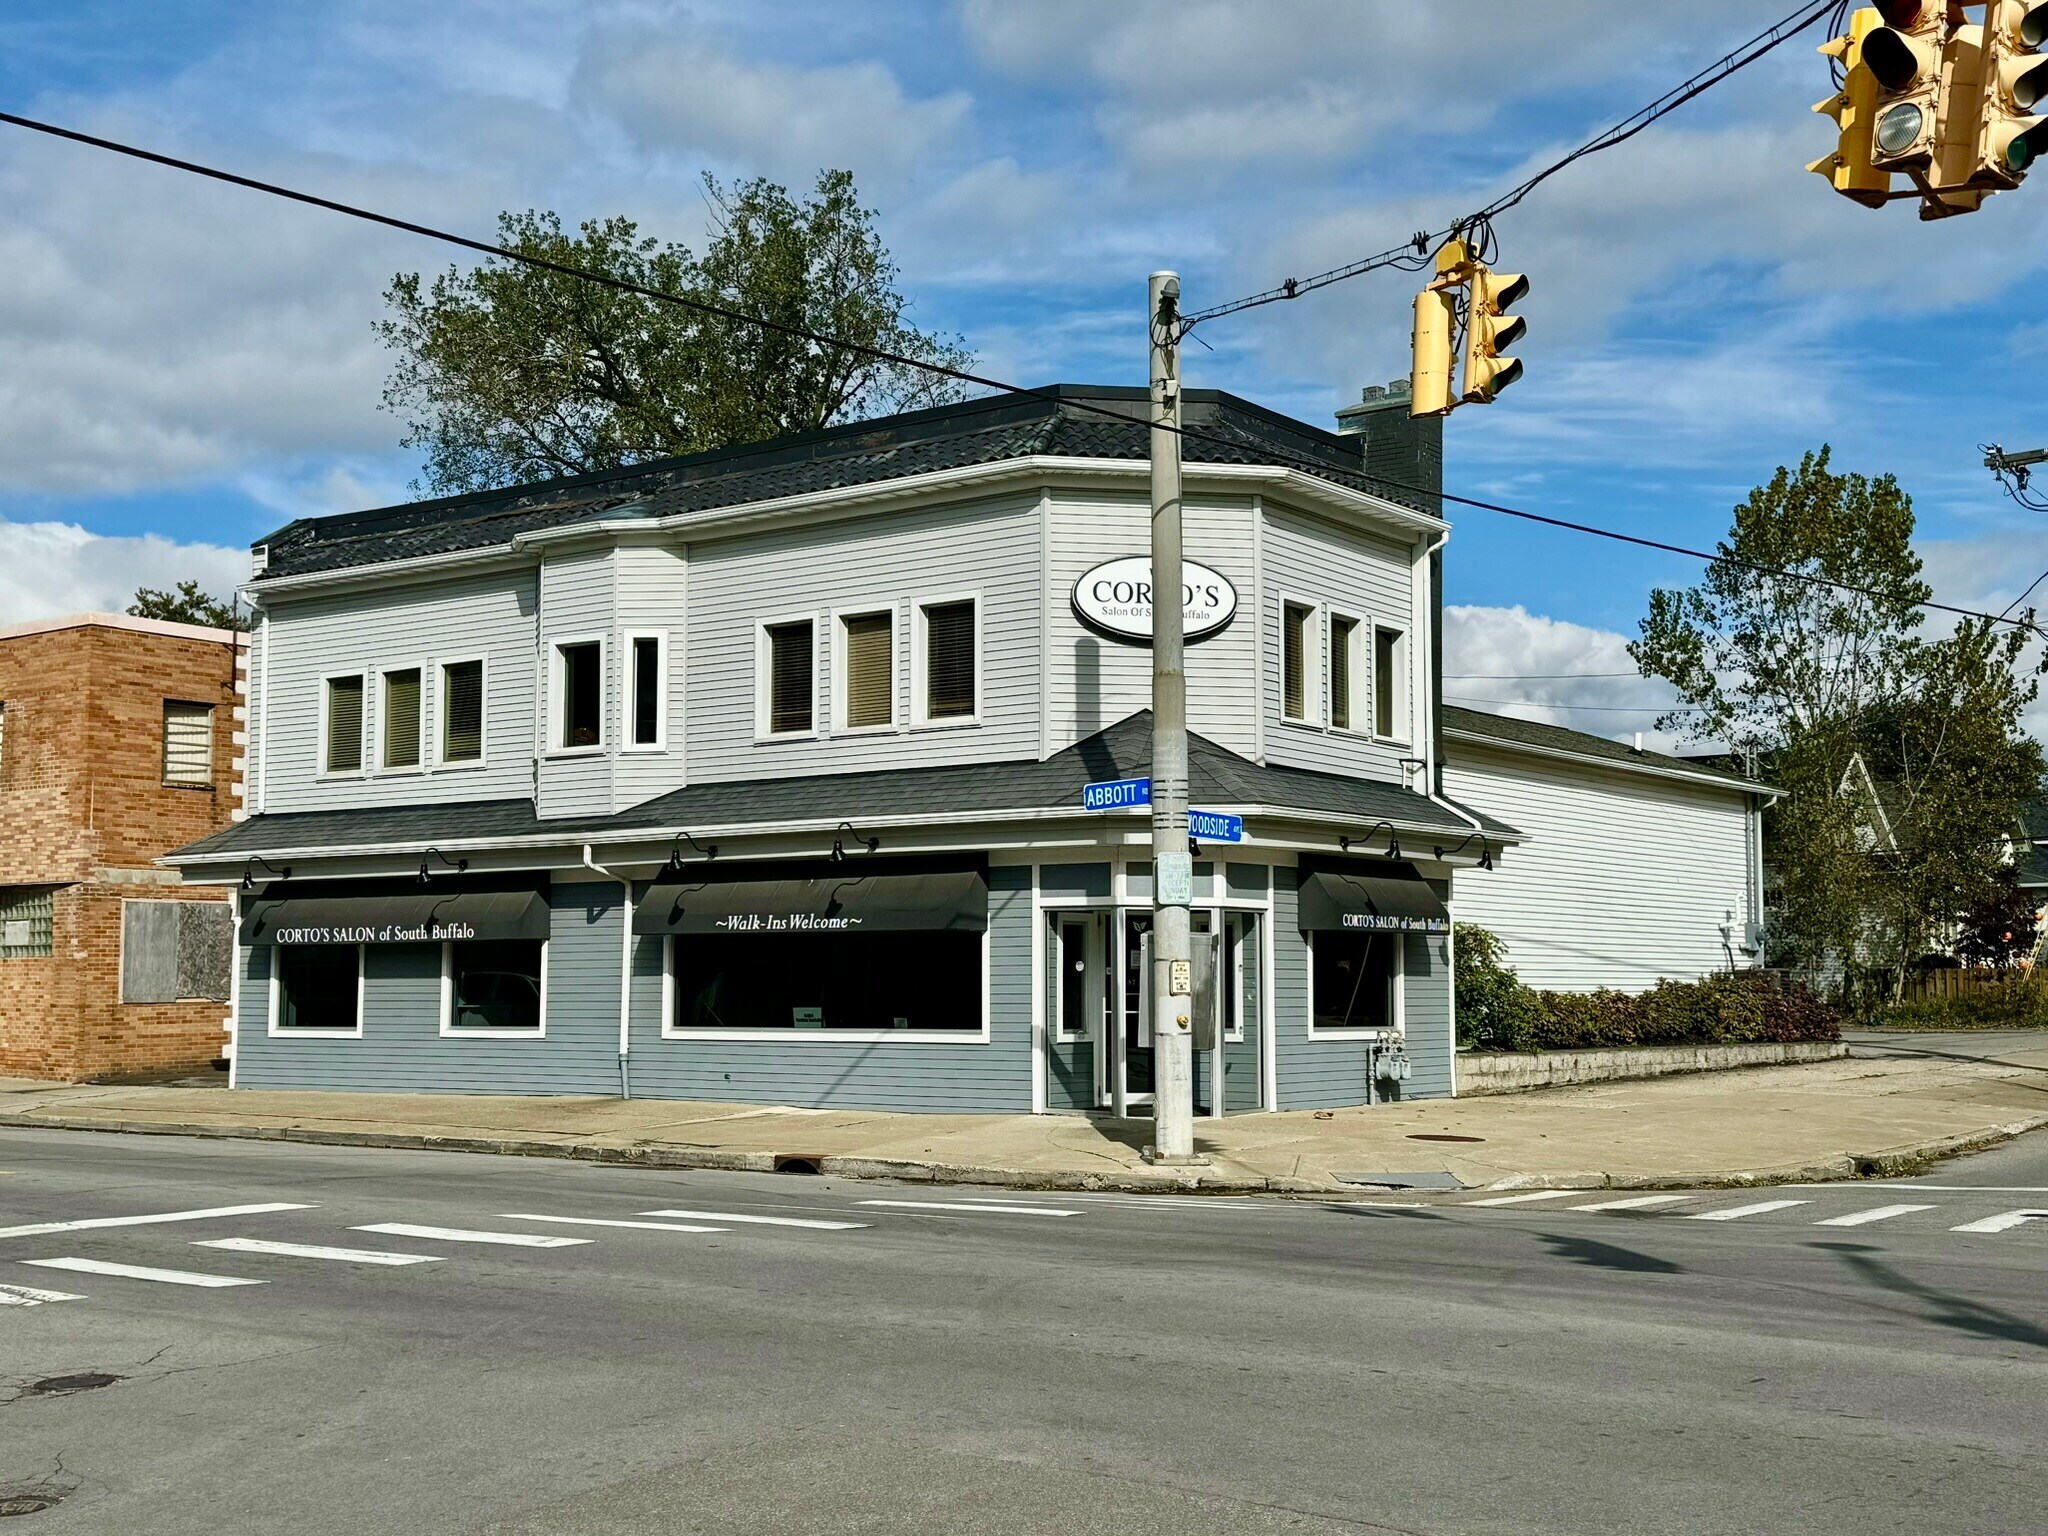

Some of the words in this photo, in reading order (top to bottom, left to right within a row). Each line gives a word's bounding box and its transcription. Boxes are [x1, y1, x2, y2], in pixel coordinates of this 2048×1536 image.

[1093, 581, 1219, 607] CORO'S
[1102, 606, 1128, 616] Salon
[1131, 607, 1144, 617] Of
[1182, 610, 1210, 619] uffalo
[1087, 784, 1136, 806] ABBOTT
[276, 927, 330, 943] CORTO'S
[333, 927, 375, 942] SALON
[379, 925, 392, 941] of
[394, 923, 428, 940] South
[432, 922, 475, 939] Buffalo
[1342, 913, 1374, 928] CORTO'S
[1375, 916, 1400, 929] SALON
[1400, 916, 1409, 930] of
[1409, 917, 1427, 930] South
[1427, 918, 1449, 931] Buffalo
